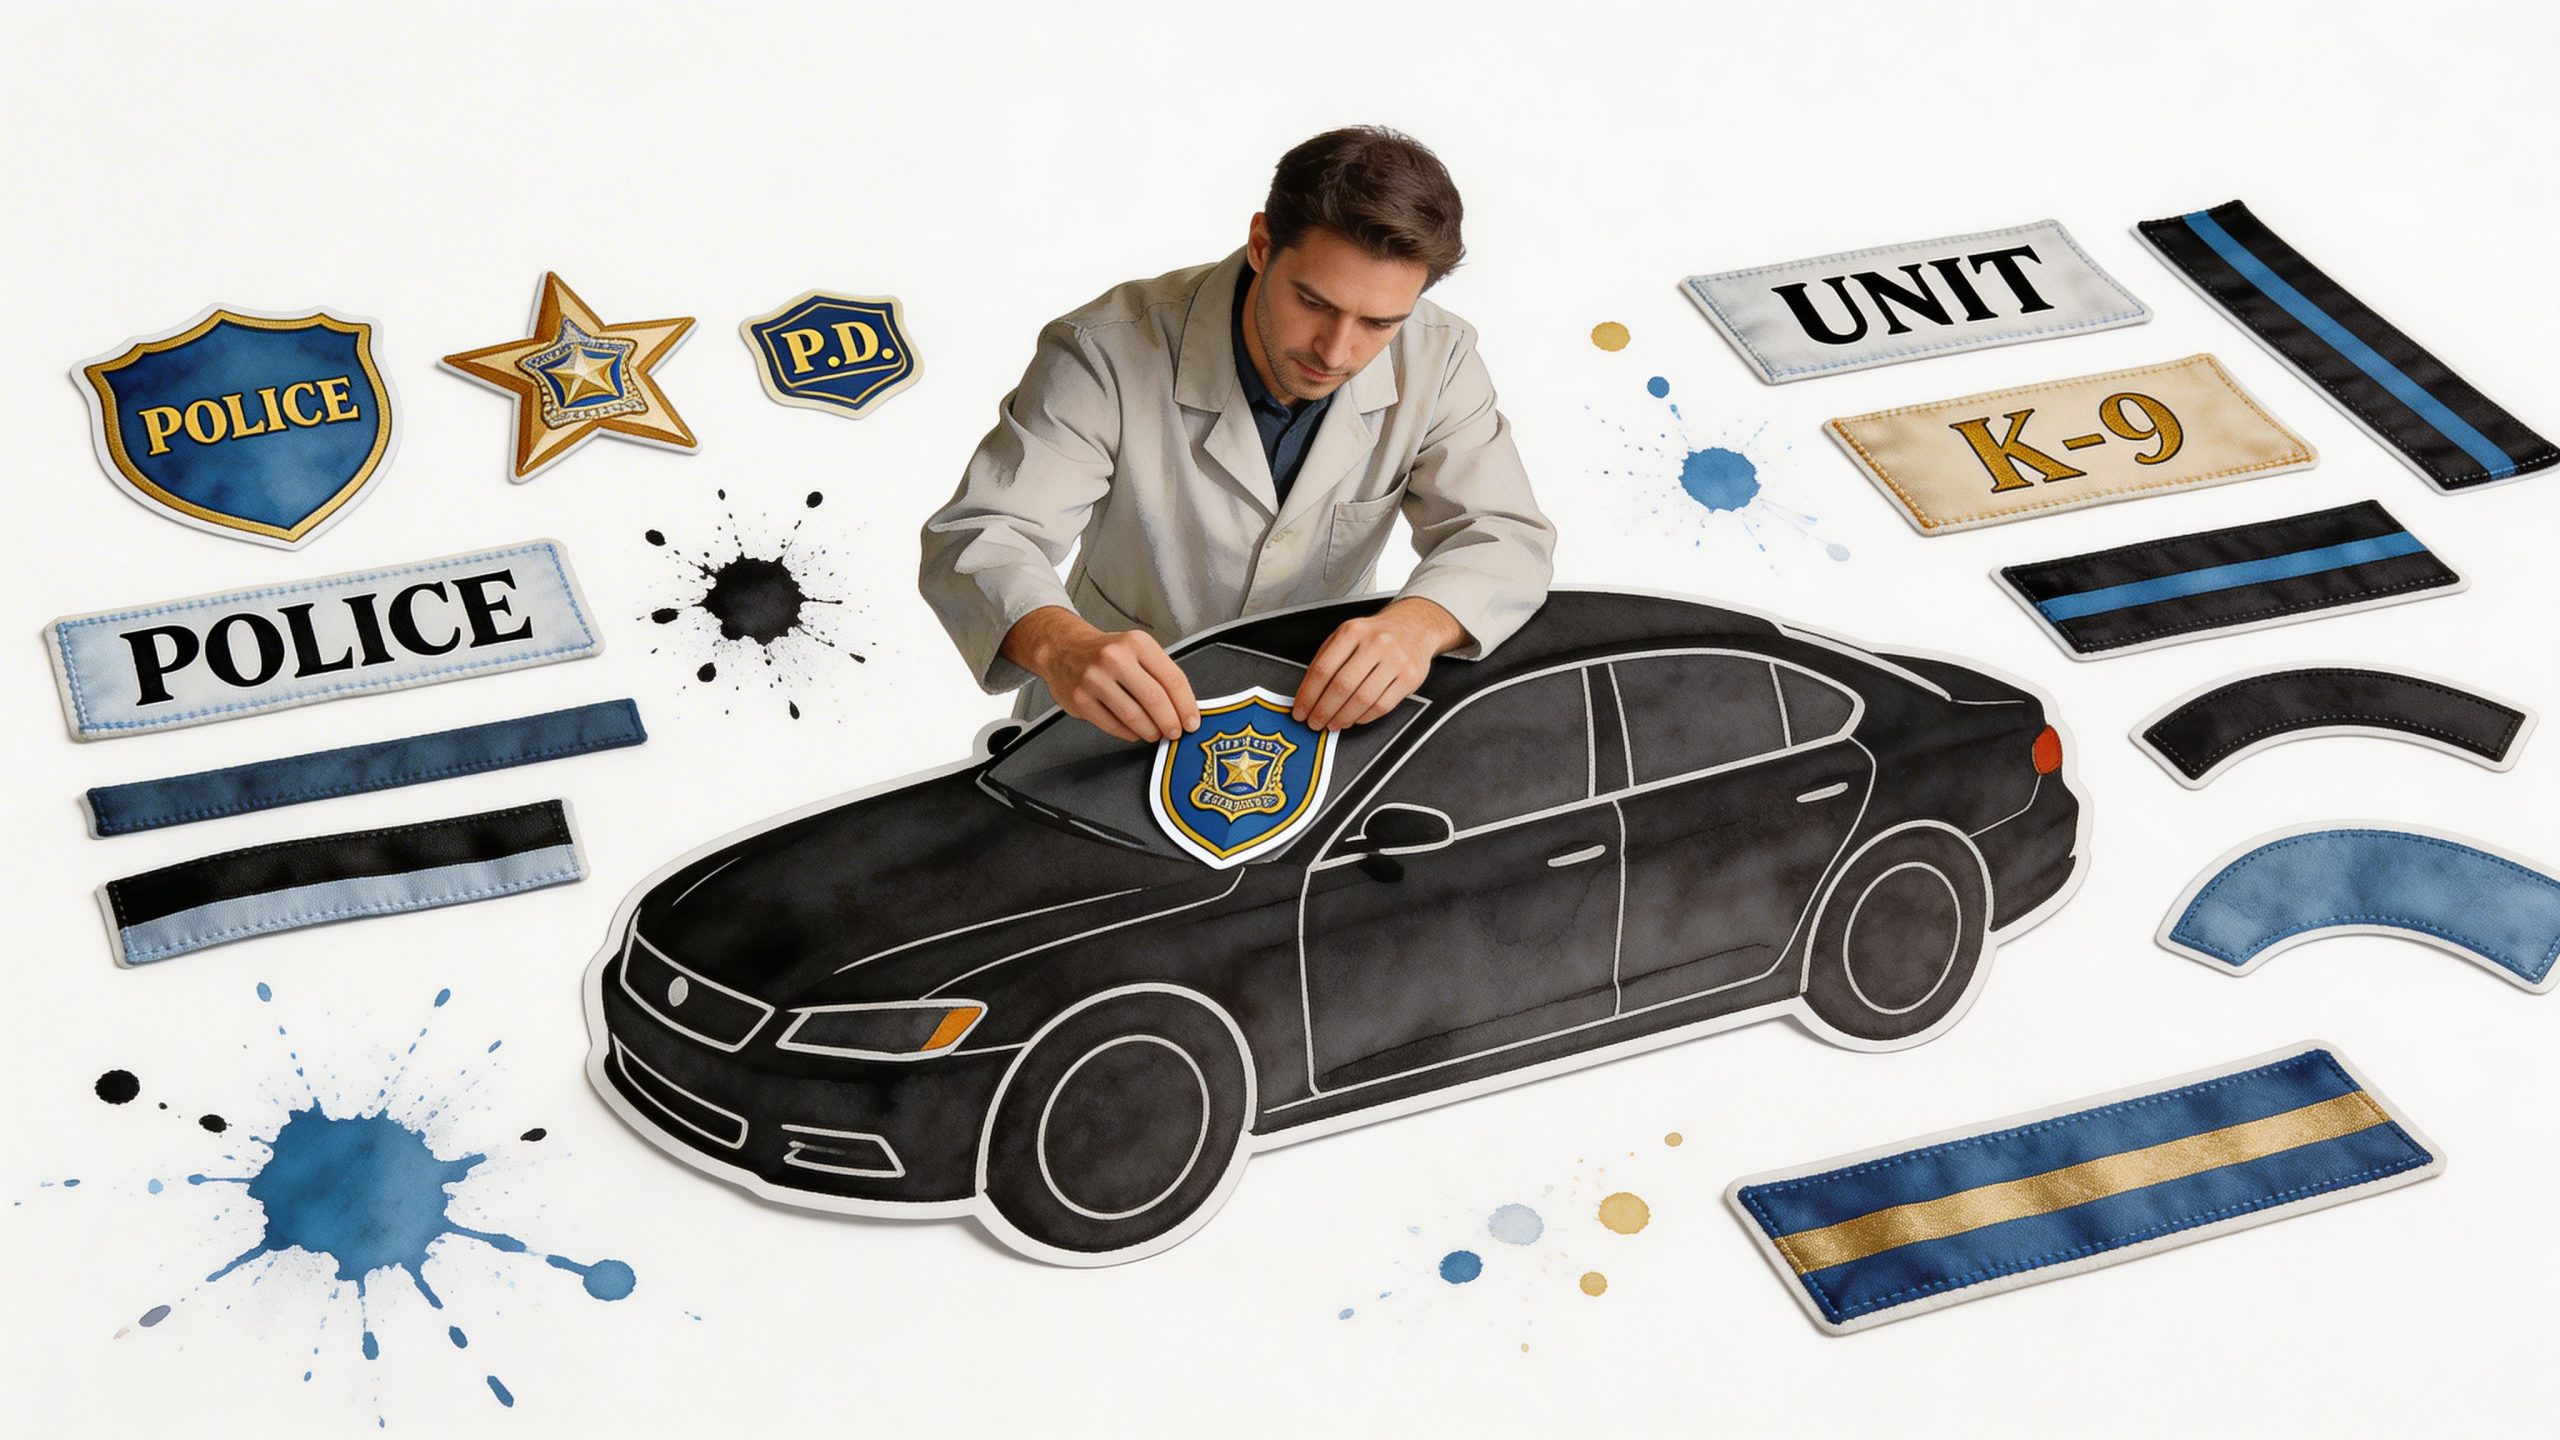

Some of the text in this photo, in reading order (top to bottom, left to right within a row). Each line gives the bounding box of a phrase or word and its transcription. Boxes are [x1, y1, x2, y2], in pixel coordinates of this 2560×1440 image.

[1771, 244, 2054, 345] UNIT
[781, 321, 896, 374] P.D.
[139, 375, 361, 457] POLICE
[1950, 391, 2185, 494] K-9
[120, 569, 533, 706] POLICE
